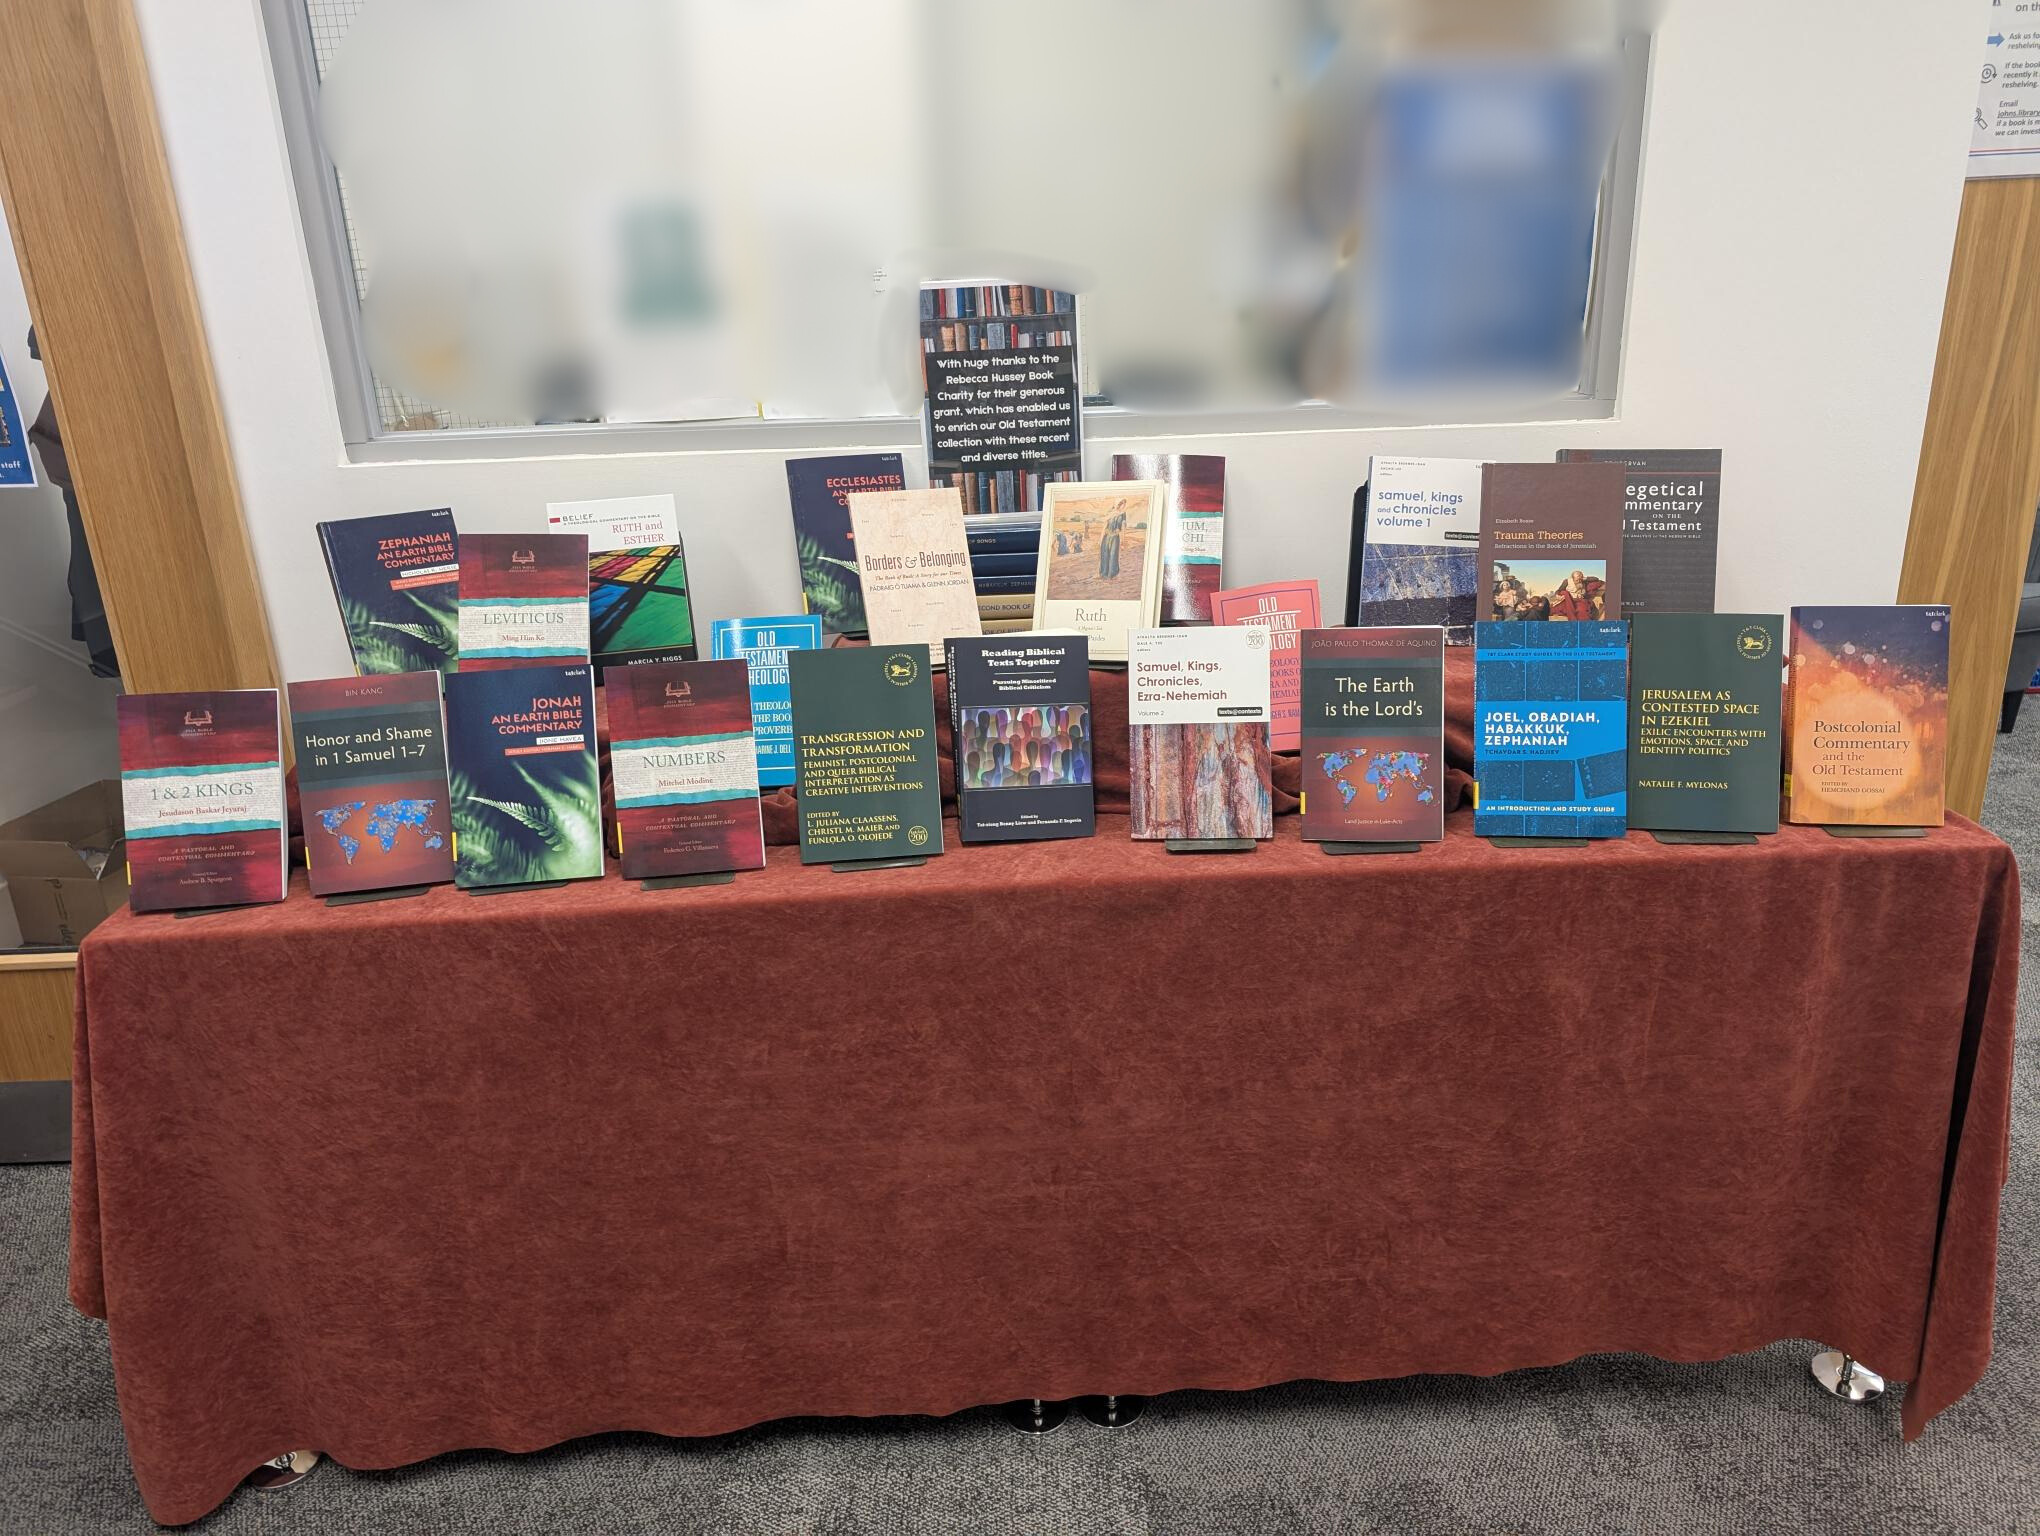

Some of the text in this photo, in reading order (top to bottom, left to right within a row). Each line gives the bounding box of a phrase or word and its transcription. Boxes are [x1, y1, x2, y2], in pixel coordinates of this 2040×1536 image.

[937, 359, 961, 369] With
[964, 358, 989, 369] huge
[992, 356, 1026, 366] thanks
[1042, 354, 1059, 363] the
[946, 371, 1054, 384] Rebecca Hussey Book
[938, 387, 1064, 402] Charity for their generous
[934, 407, 963, 419] grant,
[966, 405, 993, 414] which
[996, 404, 1014, 413] has
[1017, 402, 1056, 412] enabled
[935, 424, 945, 432] to
[948, 422, 977, 431] enrich
[999, 420, 1015, 429] Old
[1018, 417, 1070, 428] Testament
[937, 433, 1070, 448] collection with these recent
[961, 450, 1048, 462] and diverse titles.
[827, 475, 901, 488] ECCLESIASTES
[1626, 481, 1703, 500] egetical
[1379, 491, 1463, 505] samuel, kings
[1393, 504, 1457, 516] chronicles
[1625, 501, 1702, 514] mmentary
[562, 514, 593, 522] BELIEF
[1377, 516, 1430, 527] volume 1
[612, 521, 663, 533] RUTH and
[1630, 520, 1702, 530] Testament
[378, 532, 451, 550] ZEPHANIAH
[624, 534, 664, 545] ESTHER
[1494, 531, 1584, 540] Trauma Theories
[377, 543, 454, 560] AN EARTH BIBLE
[385, 552, 455, 568] COMMENTARY
[865, 549, 967, 571] Borders & Belonging
[1259, 596, 1278, 614] OLD
[483, 612, 564, 625] LEVITICUS
[1076, 608, 1107, 621] Ruth
[757, 631, 776, 647] OLD
[1312, 640, 1331, 648] JOÃO
[981, 649, 1024, 657] Reading
[1016, 658, 1060, 667] Together
[1137, 660, 1222, 672] Samuel, Kings,
[1137, 676, 1202, 687] Chronicles,
[1335, 677, 1414, 692] The Earth
[1138, 690, 1227, 701] Ezra-Nehemiah
[1642, 690, 1731, 702] JERUSALEM AS
[533, 696, 581, 712] JONAH
[1325, 703, 1336, 716] is
[1343, 701, 1370, 716] the
[1642, 703, 1760, 714] CONTESTED SPACE
[491, 709, 582, 724] AN EARTH BIBLE
[1485, 712, 1600, 724] JOEL, OBADIAH,
[1642, 716, 1711, 726] IN EZEKIEL
[499, 720, 582, 734] COMMENTARY
[1485, 724, 1570, 735] HABAKKUK,
[1813, 720, 1902, 733] Postcolonial
[306, 727, 432, 748] Honor and Shame
[801, 729, 924, 745] TRANSGRESSION AND
[1674, 729, 1737, 737] ENCOUNTERS
[1740, 730, 1766, 738] WITH
[1485, 736, 1568, 746] ZEPHANIAH
[1640, 737, 1692, 746] EMOTIONS,
[1813, 737, 1910, 752] Commentary
[315, 755, 328, 766] in
[333, 753, 339, 764] 1
[346, 747, 395, 764] Samuel
[802, 742, 910, 758] TRANSFORMATION
[1688, 747, 1731, 756] POLITICS
[1822, 752, 1864, 761] and the
[643, 750, 726, 768] NUMBERS
[804, 754, 917, 769] FEMINIST, POSTCOLONIAL
[805, 765, 897, 778] AND QUEER BIBLICAL
[1812, 764, 1903, 776] Old Testament
[658, 777, 713, 787] Mitchel Modine
[805, 775, 882, 787] INTERPRETATION
[152, 782, 254, 800] 1 & 2 KINGS
[806, 782, 923, 796] CREATIVE INTERVENTIONS
[158, 808, 194, 818] Jesudason
[816, 815, 898, 827] JULIANA CLAASSENS,
[808, 827, 844, 836] CHRISTL
